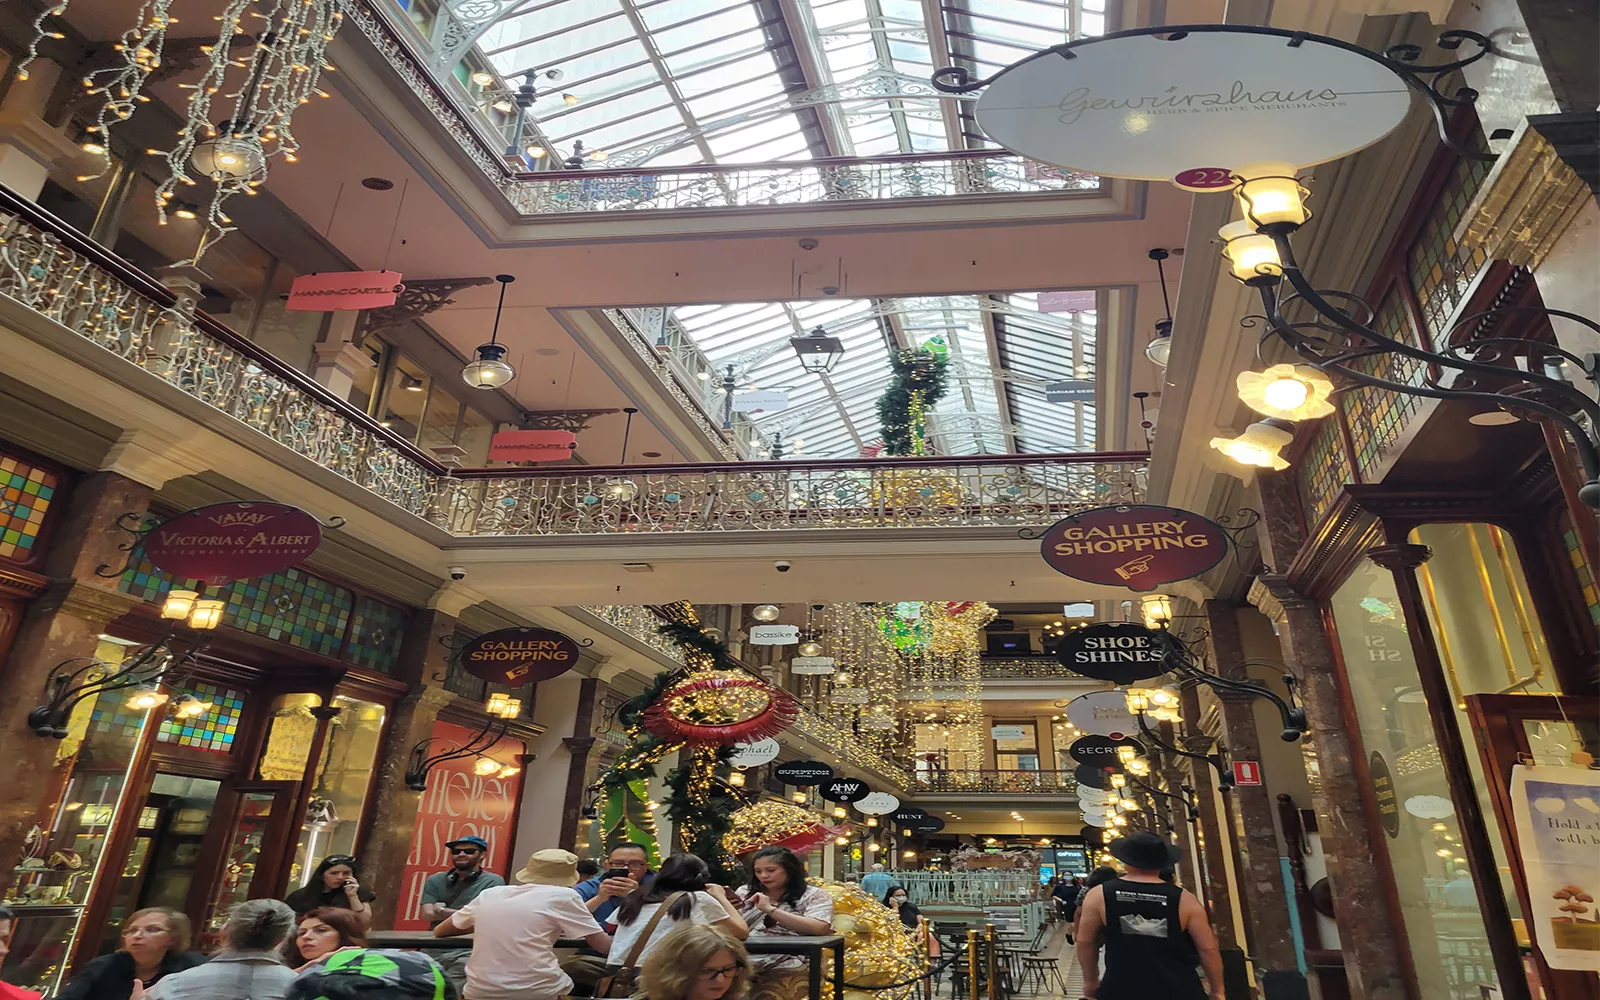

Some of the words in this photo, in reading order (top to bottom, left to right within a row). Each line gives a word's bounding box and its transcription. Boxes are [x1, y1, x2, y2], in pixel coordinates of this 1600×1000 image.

[1147, 107, 1187, 115] HERB
[1206, 104, 1249, 113] SPICE
[1253, 101, 1348, 112] MERCHANTS
[1193, 170, 1224, 185] 22
[1064, 521, 1188, 541] GALLERY
[160, 531, 231, 547] VICTORIA
[235, 536, 245, 546] &
[246, 531, 313, 548] ALBERT
[1054, 535, 1209, 556] SHOPPING
[212, 576, 227, 585] 17
[755, 631, 792, 639] bassike
[480, 640, 563, 651] GALLERY
[1083, 636, 1151, 650] SHOE
[470, 650, 569, 661] SHOPPING
[1074, 649, 1164, 664] SHINES
[829, 783, 860, 792] AHW
[1547, 816, 1581, 830] Hold
[406, 817, 424, 866] A
[1555, 833, 1587, 845] with
